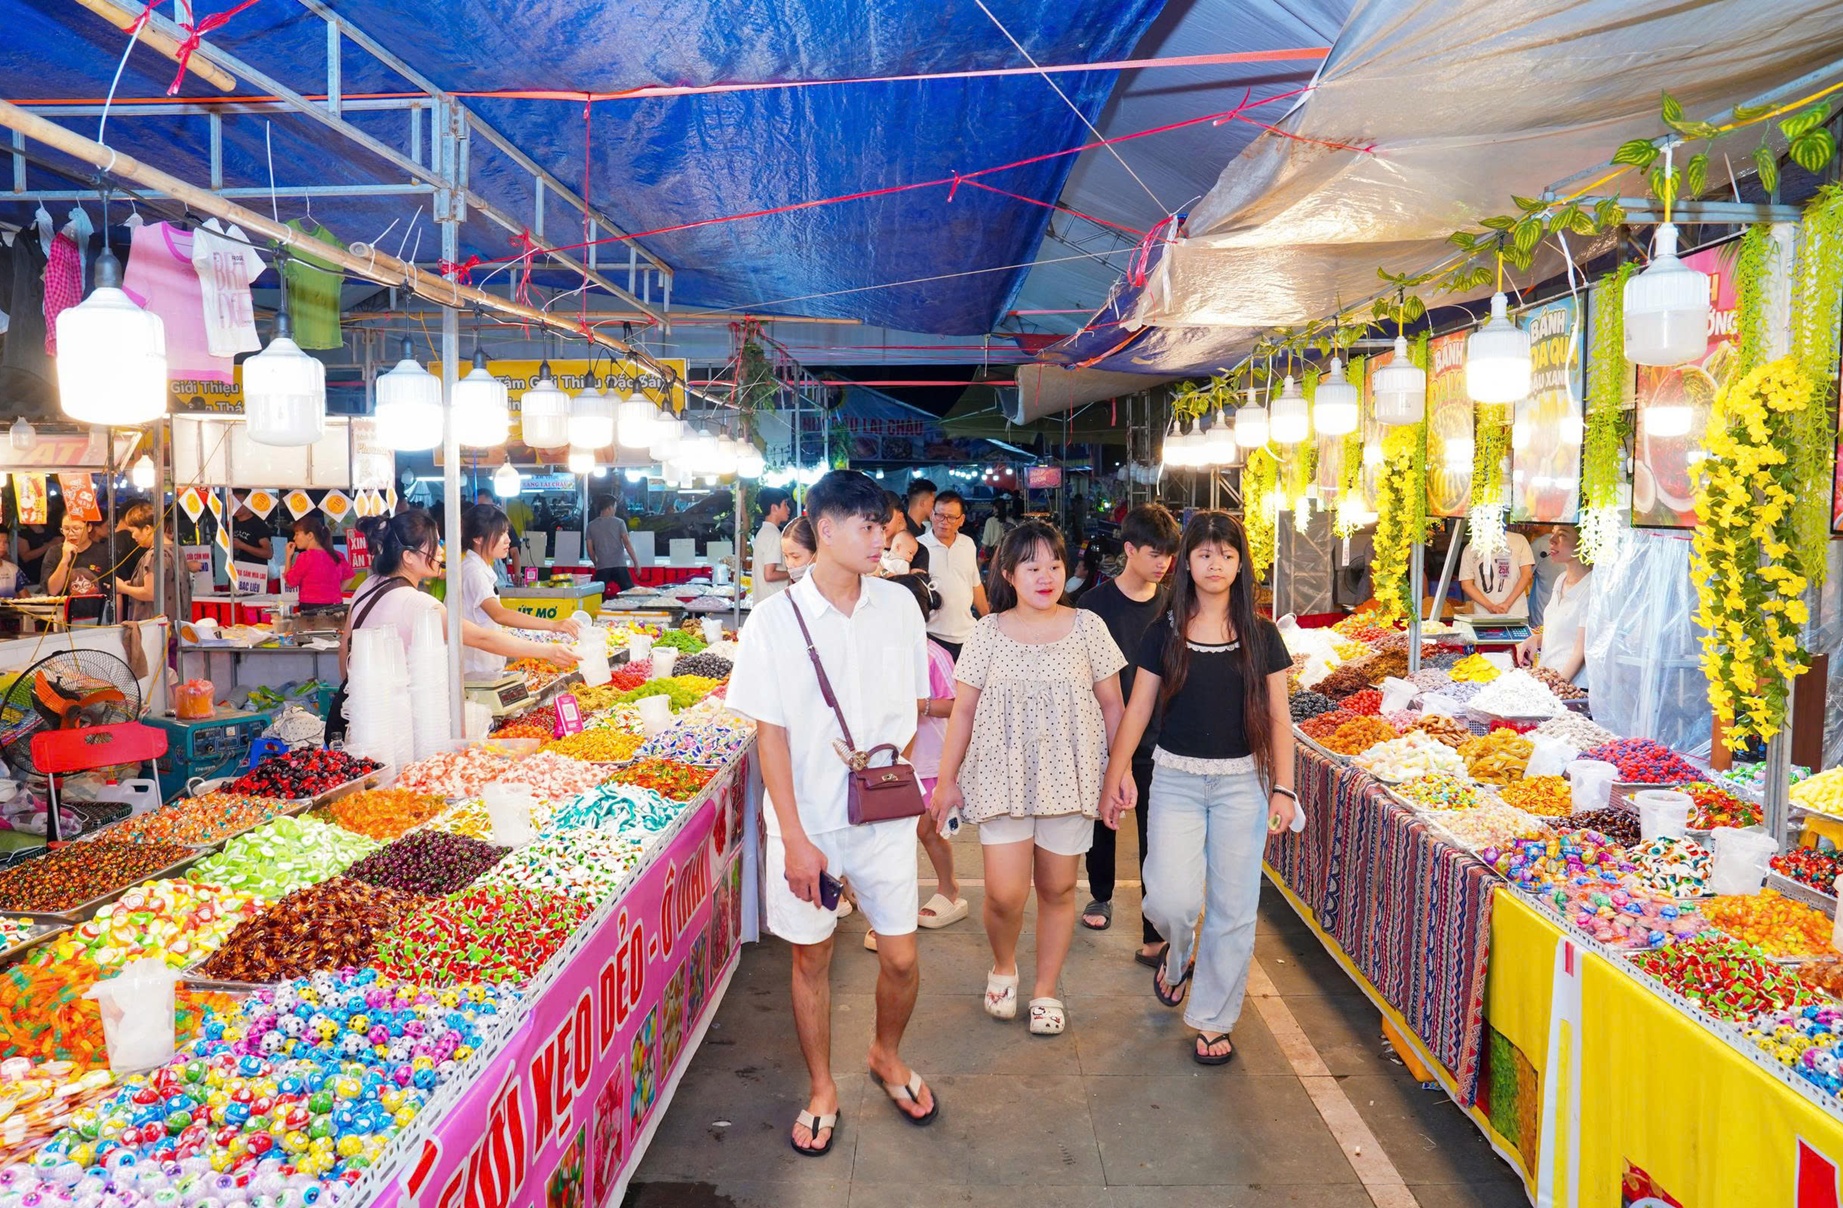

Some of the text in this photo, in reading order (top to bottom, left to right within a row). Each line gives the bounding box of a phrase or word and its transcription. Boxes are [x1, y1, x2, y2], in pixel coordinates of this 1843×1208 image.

[1531, 308, 1565, 344] BÁNH
[1435, 340, 1463, 373] BÁNH
[171, 381, 197, 393] Giới
[887, 415, 923, 436] CHÂU
[351, 536, 366, 549] XIN
[352, 553, 365, 567] ĂN
[536, 606, 558, 619] MƠ
[532, 993, 592, 1149] KẸO
[601, 912, 643, 1054] DẺO
[661, 868, 675, 957] Ô
